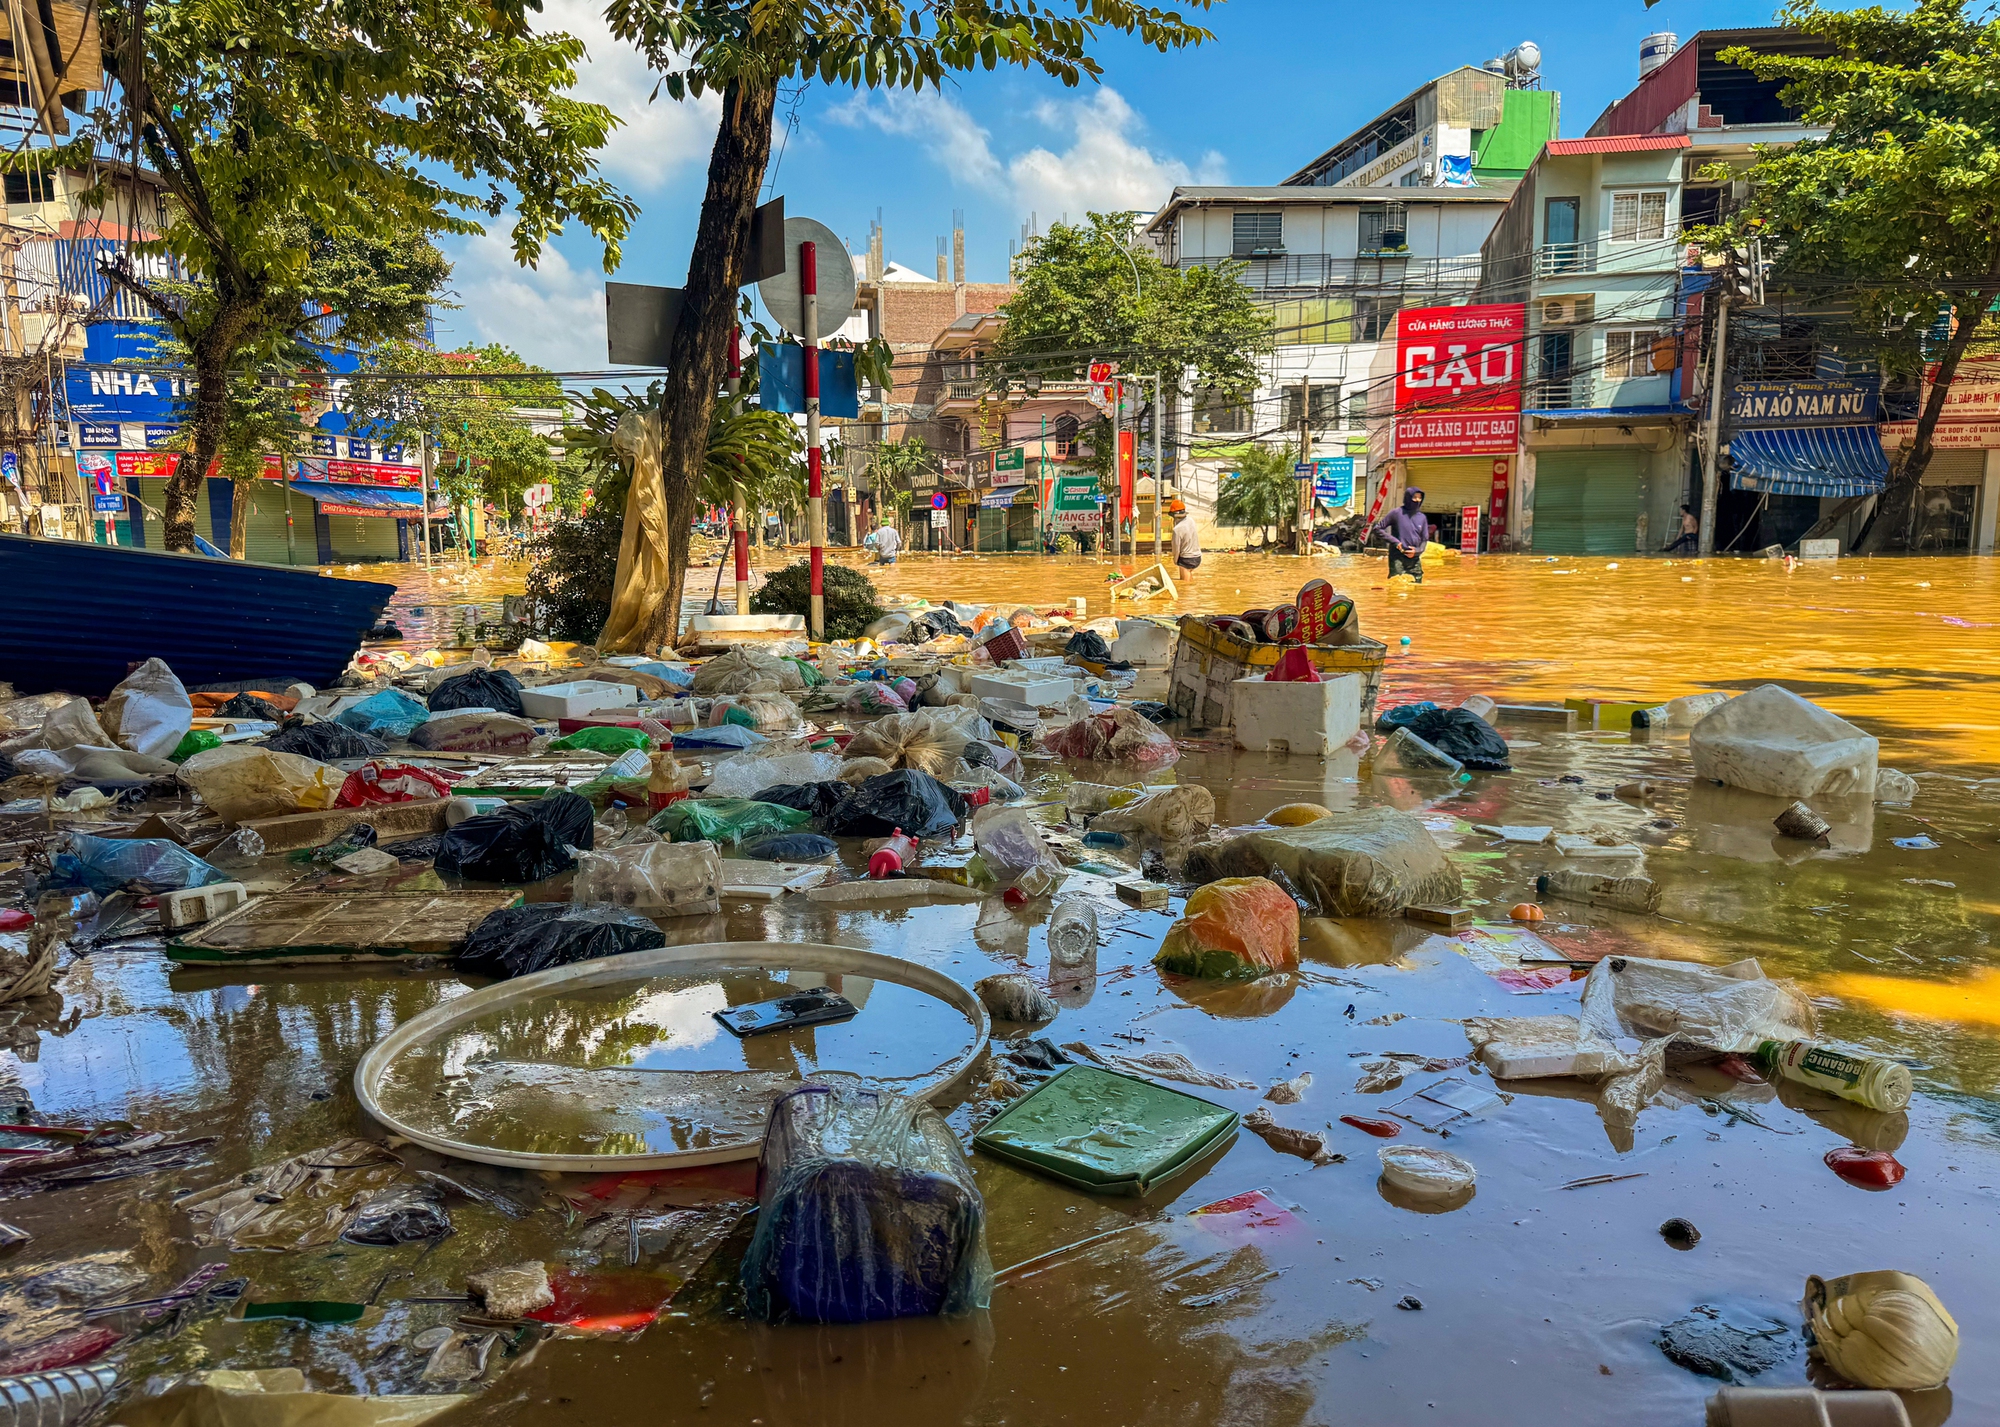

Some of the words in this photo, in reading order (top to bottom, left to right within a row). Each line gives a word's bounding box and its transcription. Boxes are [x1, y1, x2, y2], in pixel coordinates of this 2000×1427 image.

[1408, 319, 1427, 331] CỬA
[1429, 318, 1455, 330] HÀNG
[1457, 318, 1487, 329] LƯƠNG
[1489, 317, 1513, 329] THỰC
[1405, 343, 1513, 397] GẠO
[1768, 393, 1793, 417] ÁO
[1795, 395, 1836, 417] NAM
[1837, 387, 1869, 414] NỮ
[1399, 421, 1424, 438] CỬA
[1426, 420, 1462, 437] HÀNG
[1465, 421, 1488, 439] LỤC
[1490, 420, 1515, 438] GẠO
[133, 461, 155, 474] 25
[1807, 1053, 1863, 1076] BOGANIC
